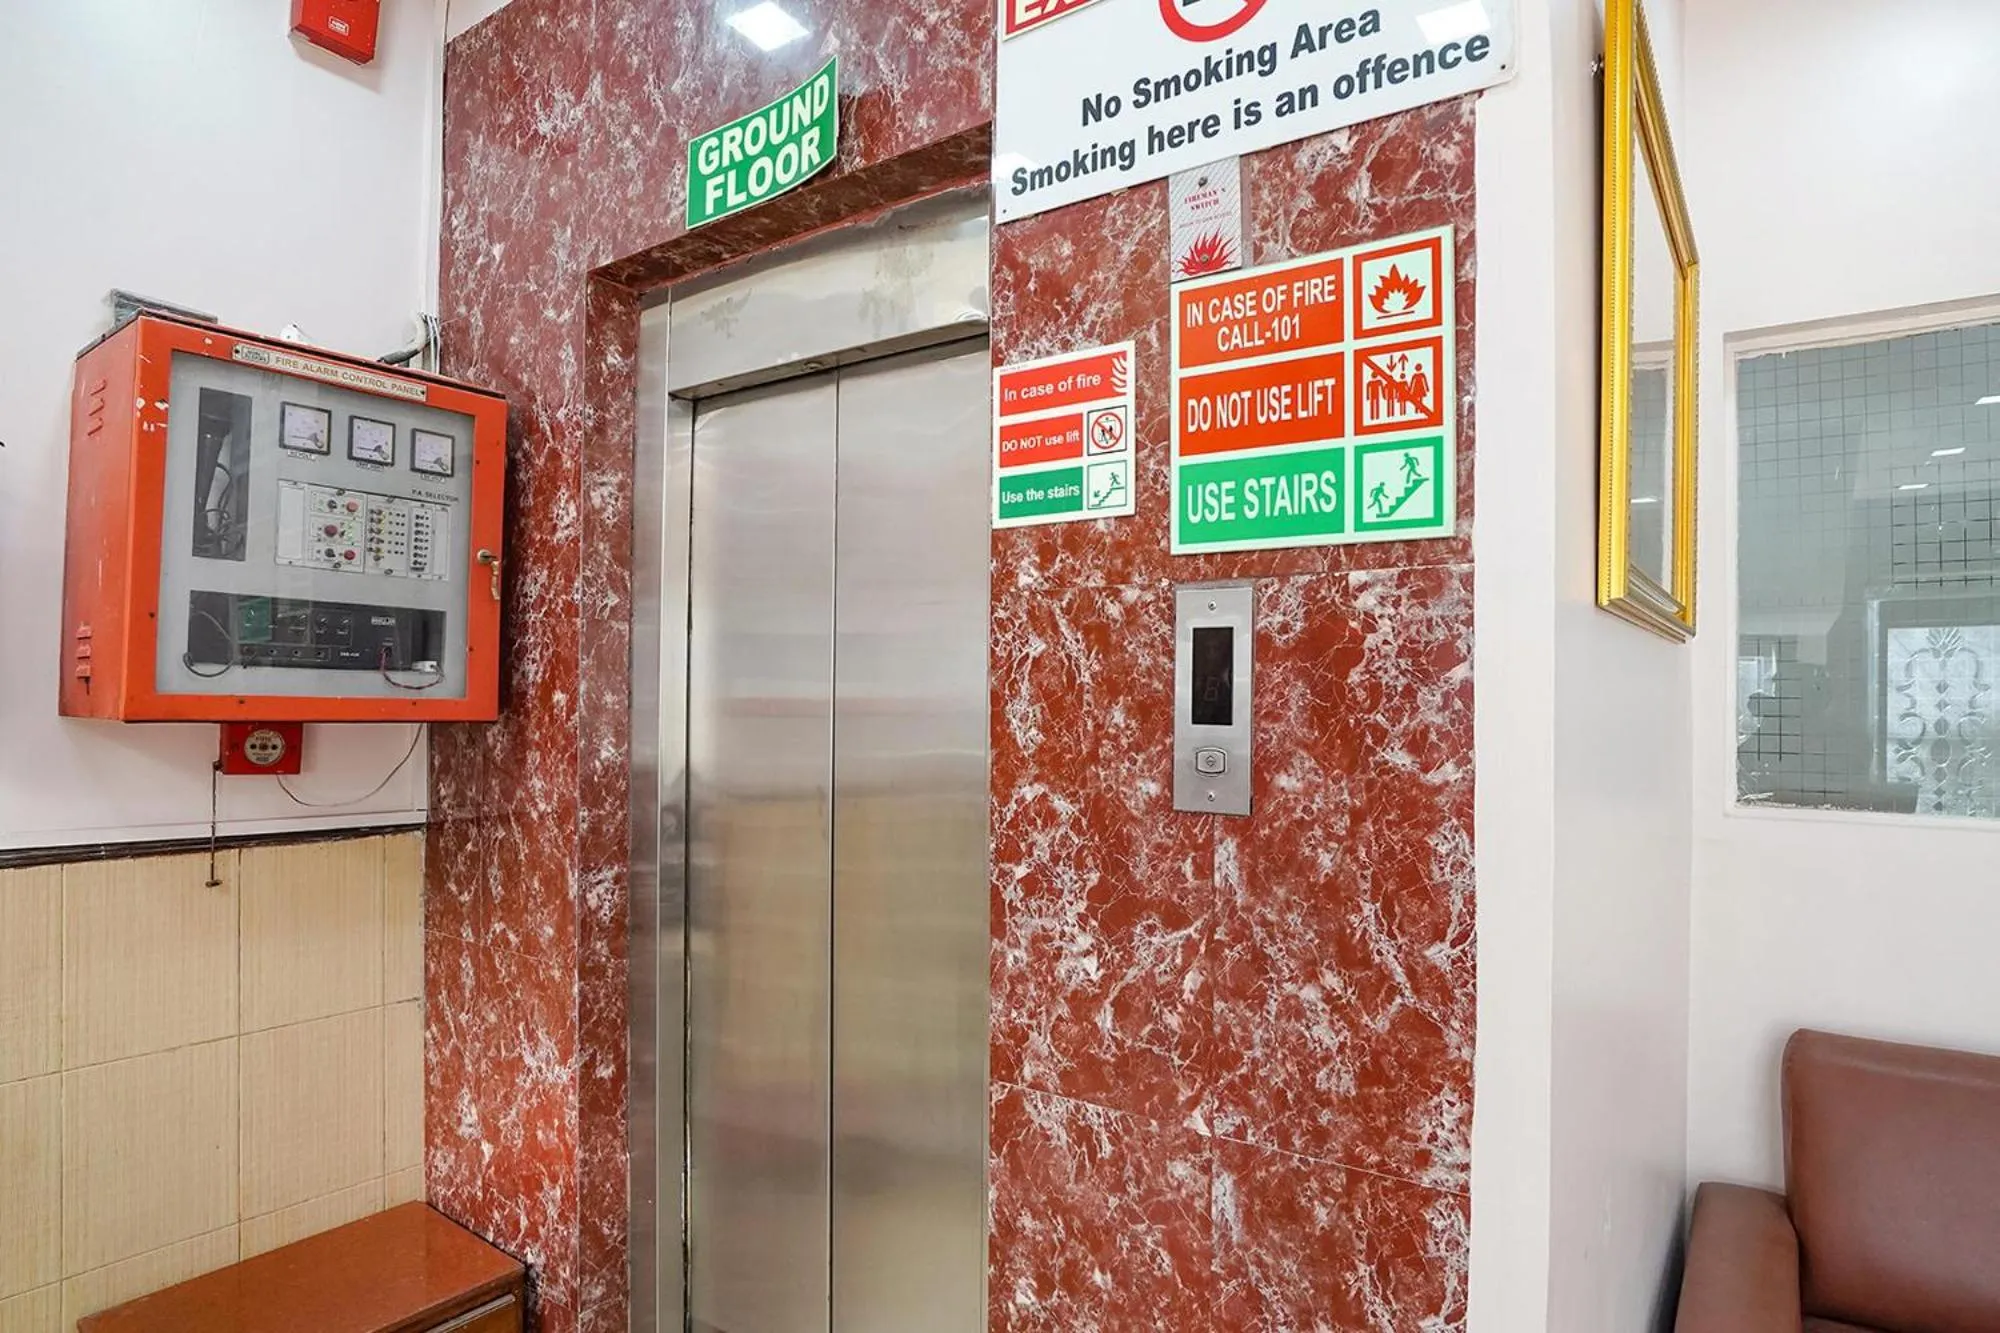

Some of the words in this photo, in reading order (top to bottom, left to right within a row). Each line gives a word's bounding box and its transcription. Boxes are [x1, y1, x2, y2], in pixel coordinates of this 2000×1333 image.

[1082, 93, 1121, 127] No
[1132, 39, 1278, 109] Smoking
[1290, 9, 1381, 59] Area
[697, 73, 830, 176] GROUND
[1011, 138, 1136, 197] Smoking
[1147, 113, 1221, 157] here
[1233, 99, 1261, 130] is
[1275, 82, 1319, 116] an
[1333, 34, 1491, 100] offence
[705, 126, 821, 216] FLOOR
[1186, 301, 1203, 328] IN
[1208, 290, 1257, 324] CASE
[1262, 284, 1288, 314] OF
[1293, 274, 1337, 308] FIRE
[1217, 313, 1300, 352] CALL-101
[275, 356, 299, 370] FIRE
[302, 360, 338, 379] ALARM
[341, 371, 388, 389] CONTROL
[391, 382, 421, 397] PANEL
[1004, 387, 1017, 402] In
[1020, 383, 1054, 399] case
[1057, 375, 1074, 393] of
[1076, 374, 1101, 389] fire
[1187, 396, 1212, 433] DO
[1216, 391, 1251, 429] NOT
[1256, 384, 1292, 425] USE
[1297, 378, 1336, 419] LIFT
[1002, 439, 1018, 452] DO
[1020, 435, 1044, 450] NOT
[1045, 434, 1064, 446] use
[1066, 430, 1080, 443] lift
[1002, 490, 1023, 504] Use
[1026, 488, 1045, 502] the
[1047, 484, 1080, 499] stairs
[1187, 481, 1236, 524] USE
[1243, 470, 1337, 520] STAIRS
